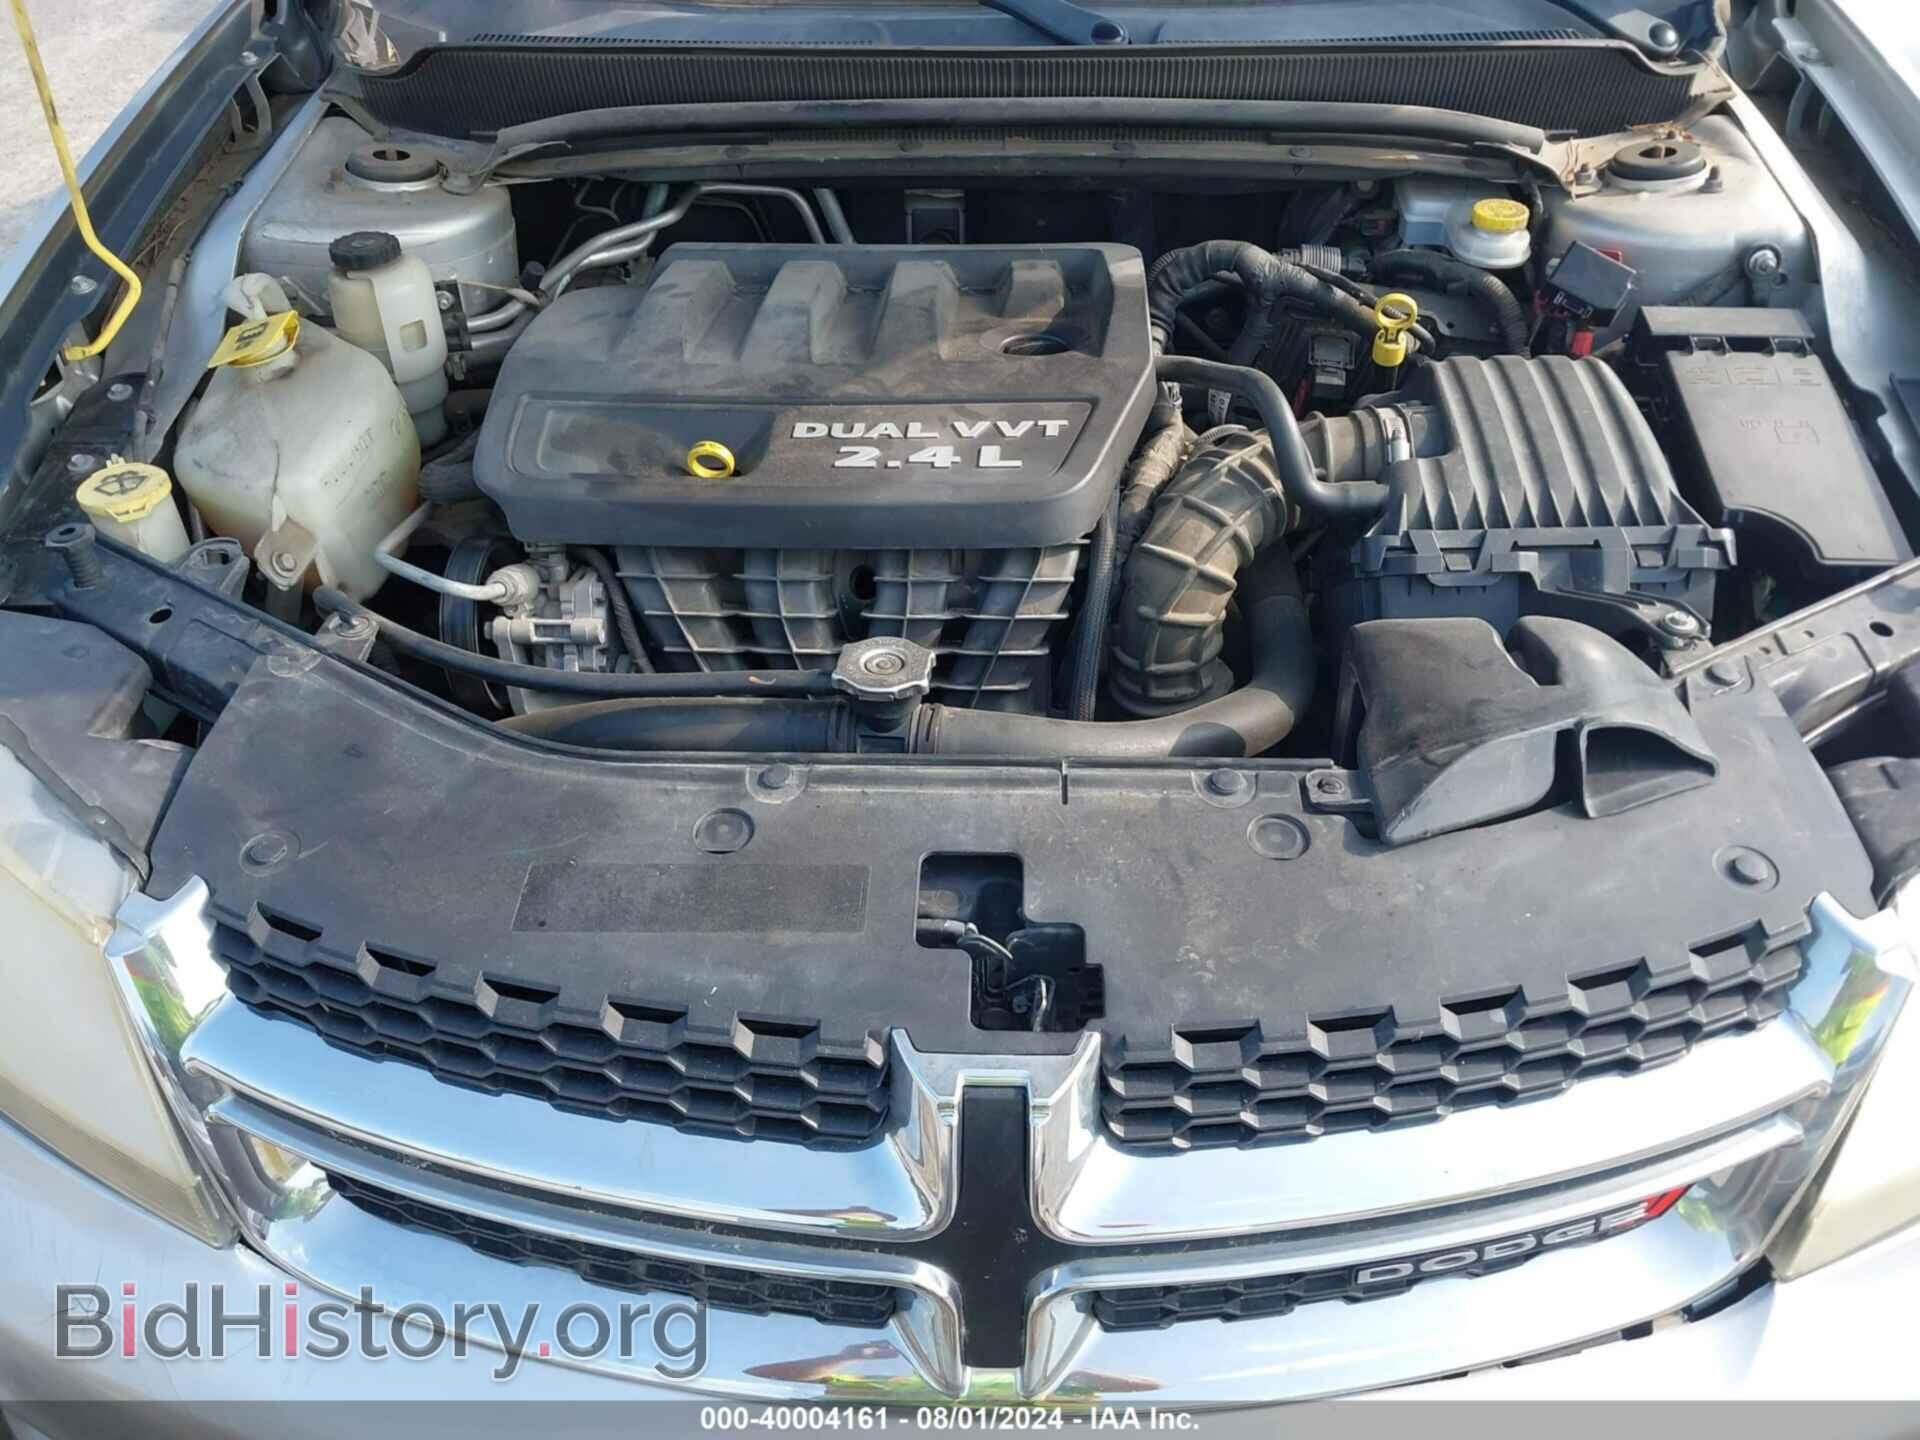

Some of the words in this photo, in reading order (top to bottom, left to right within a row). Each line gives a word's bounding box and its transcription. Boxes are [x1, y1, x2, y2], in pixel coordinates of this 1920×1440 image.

[791, 421, 940, 439] DUAL
[952, 419, 1070, 438] VVT
[1356, 1200, 1650, 1285] DODGE
